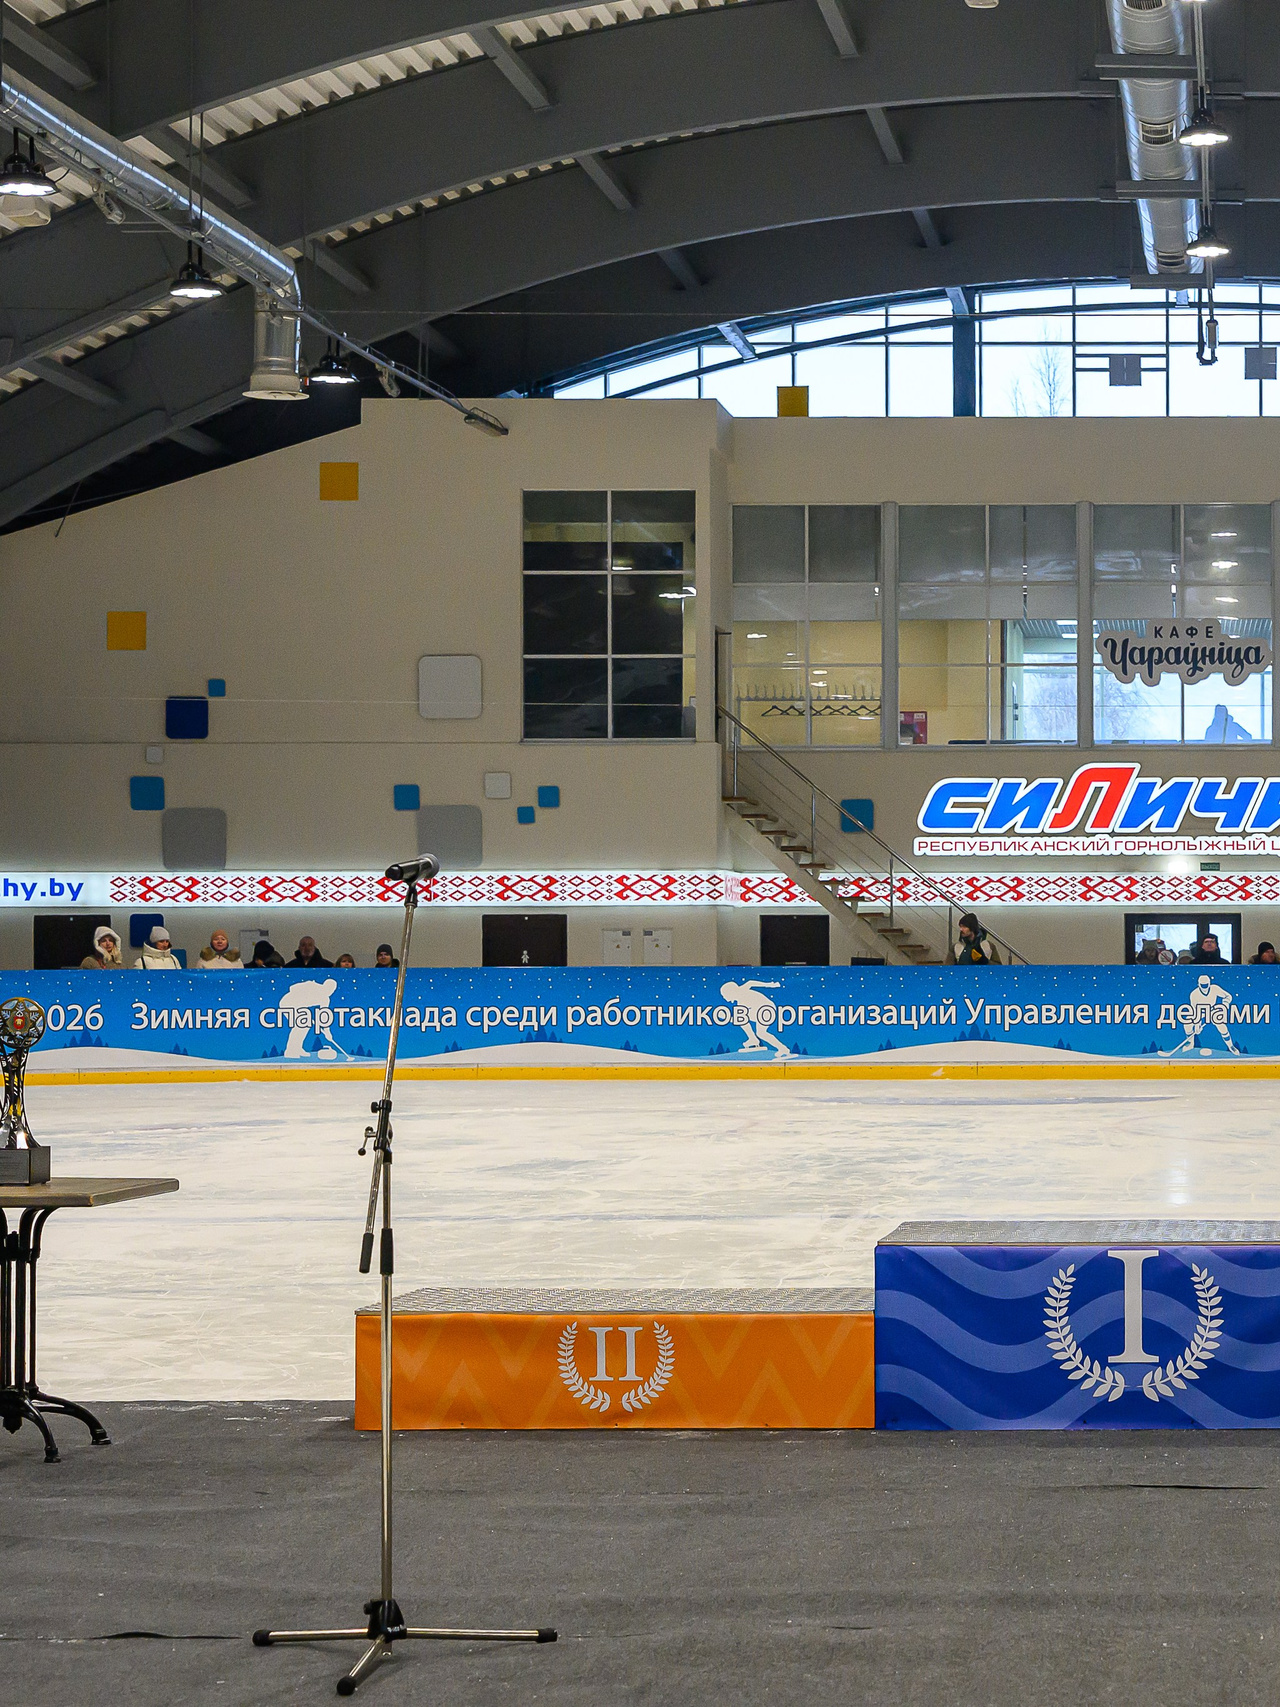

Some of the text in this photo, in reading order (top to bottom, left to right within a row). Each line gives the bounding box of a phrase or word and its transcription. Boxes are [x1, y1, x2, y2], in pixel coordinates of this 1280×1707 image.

[1154, 626, 1214, 639] КАФЕ
[917, 838, 1110, 852] РЕСПУБЛИКАНСКИЙ
[1114, 838, 1266, 851] ГОРНОЛЫЖНЫЙ
[0, 877, 84, 901] hy.by
[46, 1003, 104, 1031] 026
[130, 1001, 251, 1030] Зимняя
[258, 1005, 458, 1034] спартакиада
[465, 1005, 558, 1034] среди
[566, 997, 752, 1033] работников
[756, 998, 957, 1033] организаций
[964, 997, 1149, 1032] Управления
[1155, 1003, 1271, 1030] делами
[1107, 1249, 1160, 1364] I
[588, 1326, 644, 1381] II
